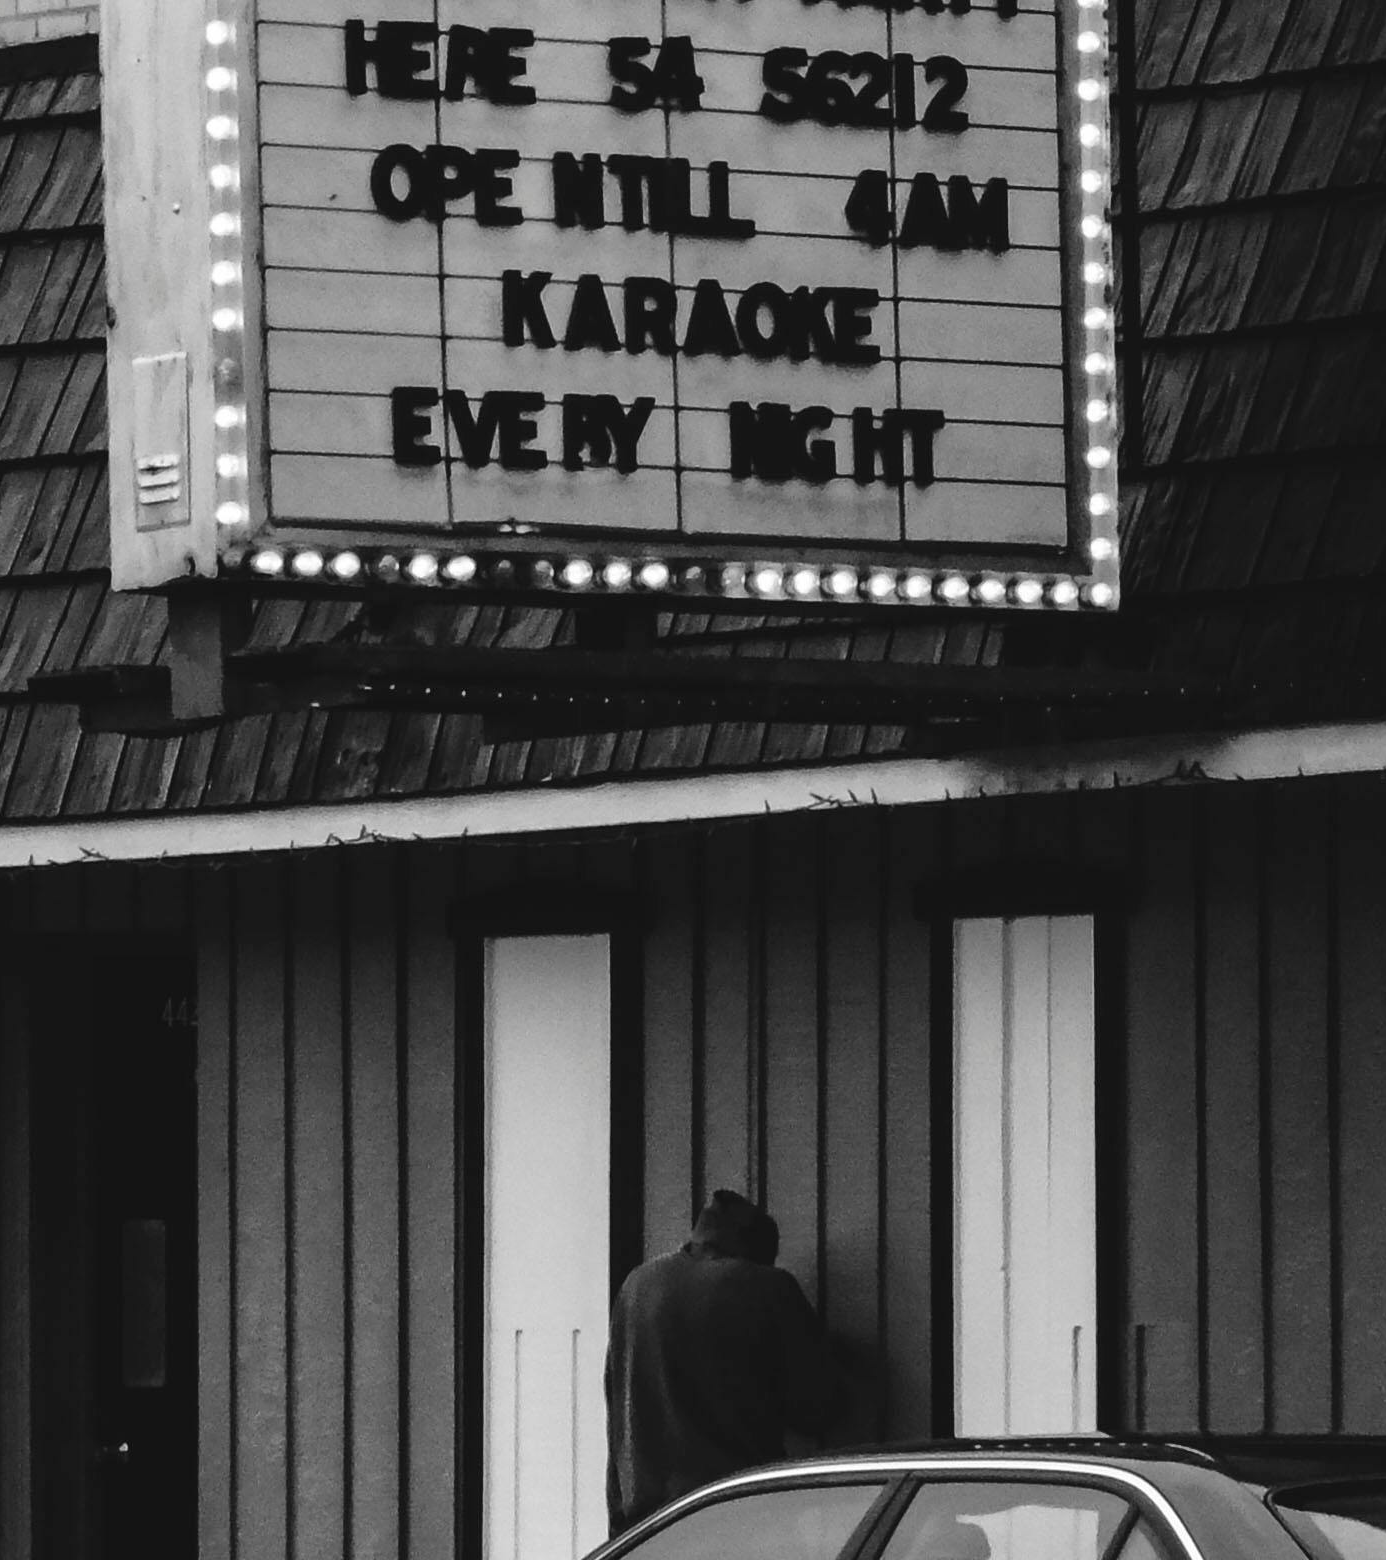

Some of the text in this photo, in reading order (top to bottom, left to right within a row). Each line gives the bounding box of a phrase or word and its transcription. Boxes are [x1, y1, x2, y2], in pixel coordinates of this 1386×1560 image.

[344, 18, 537, 105] HERE
[502, 269, 881, 365] KARAOKE
[392, 386, 655, 474] EVERY
